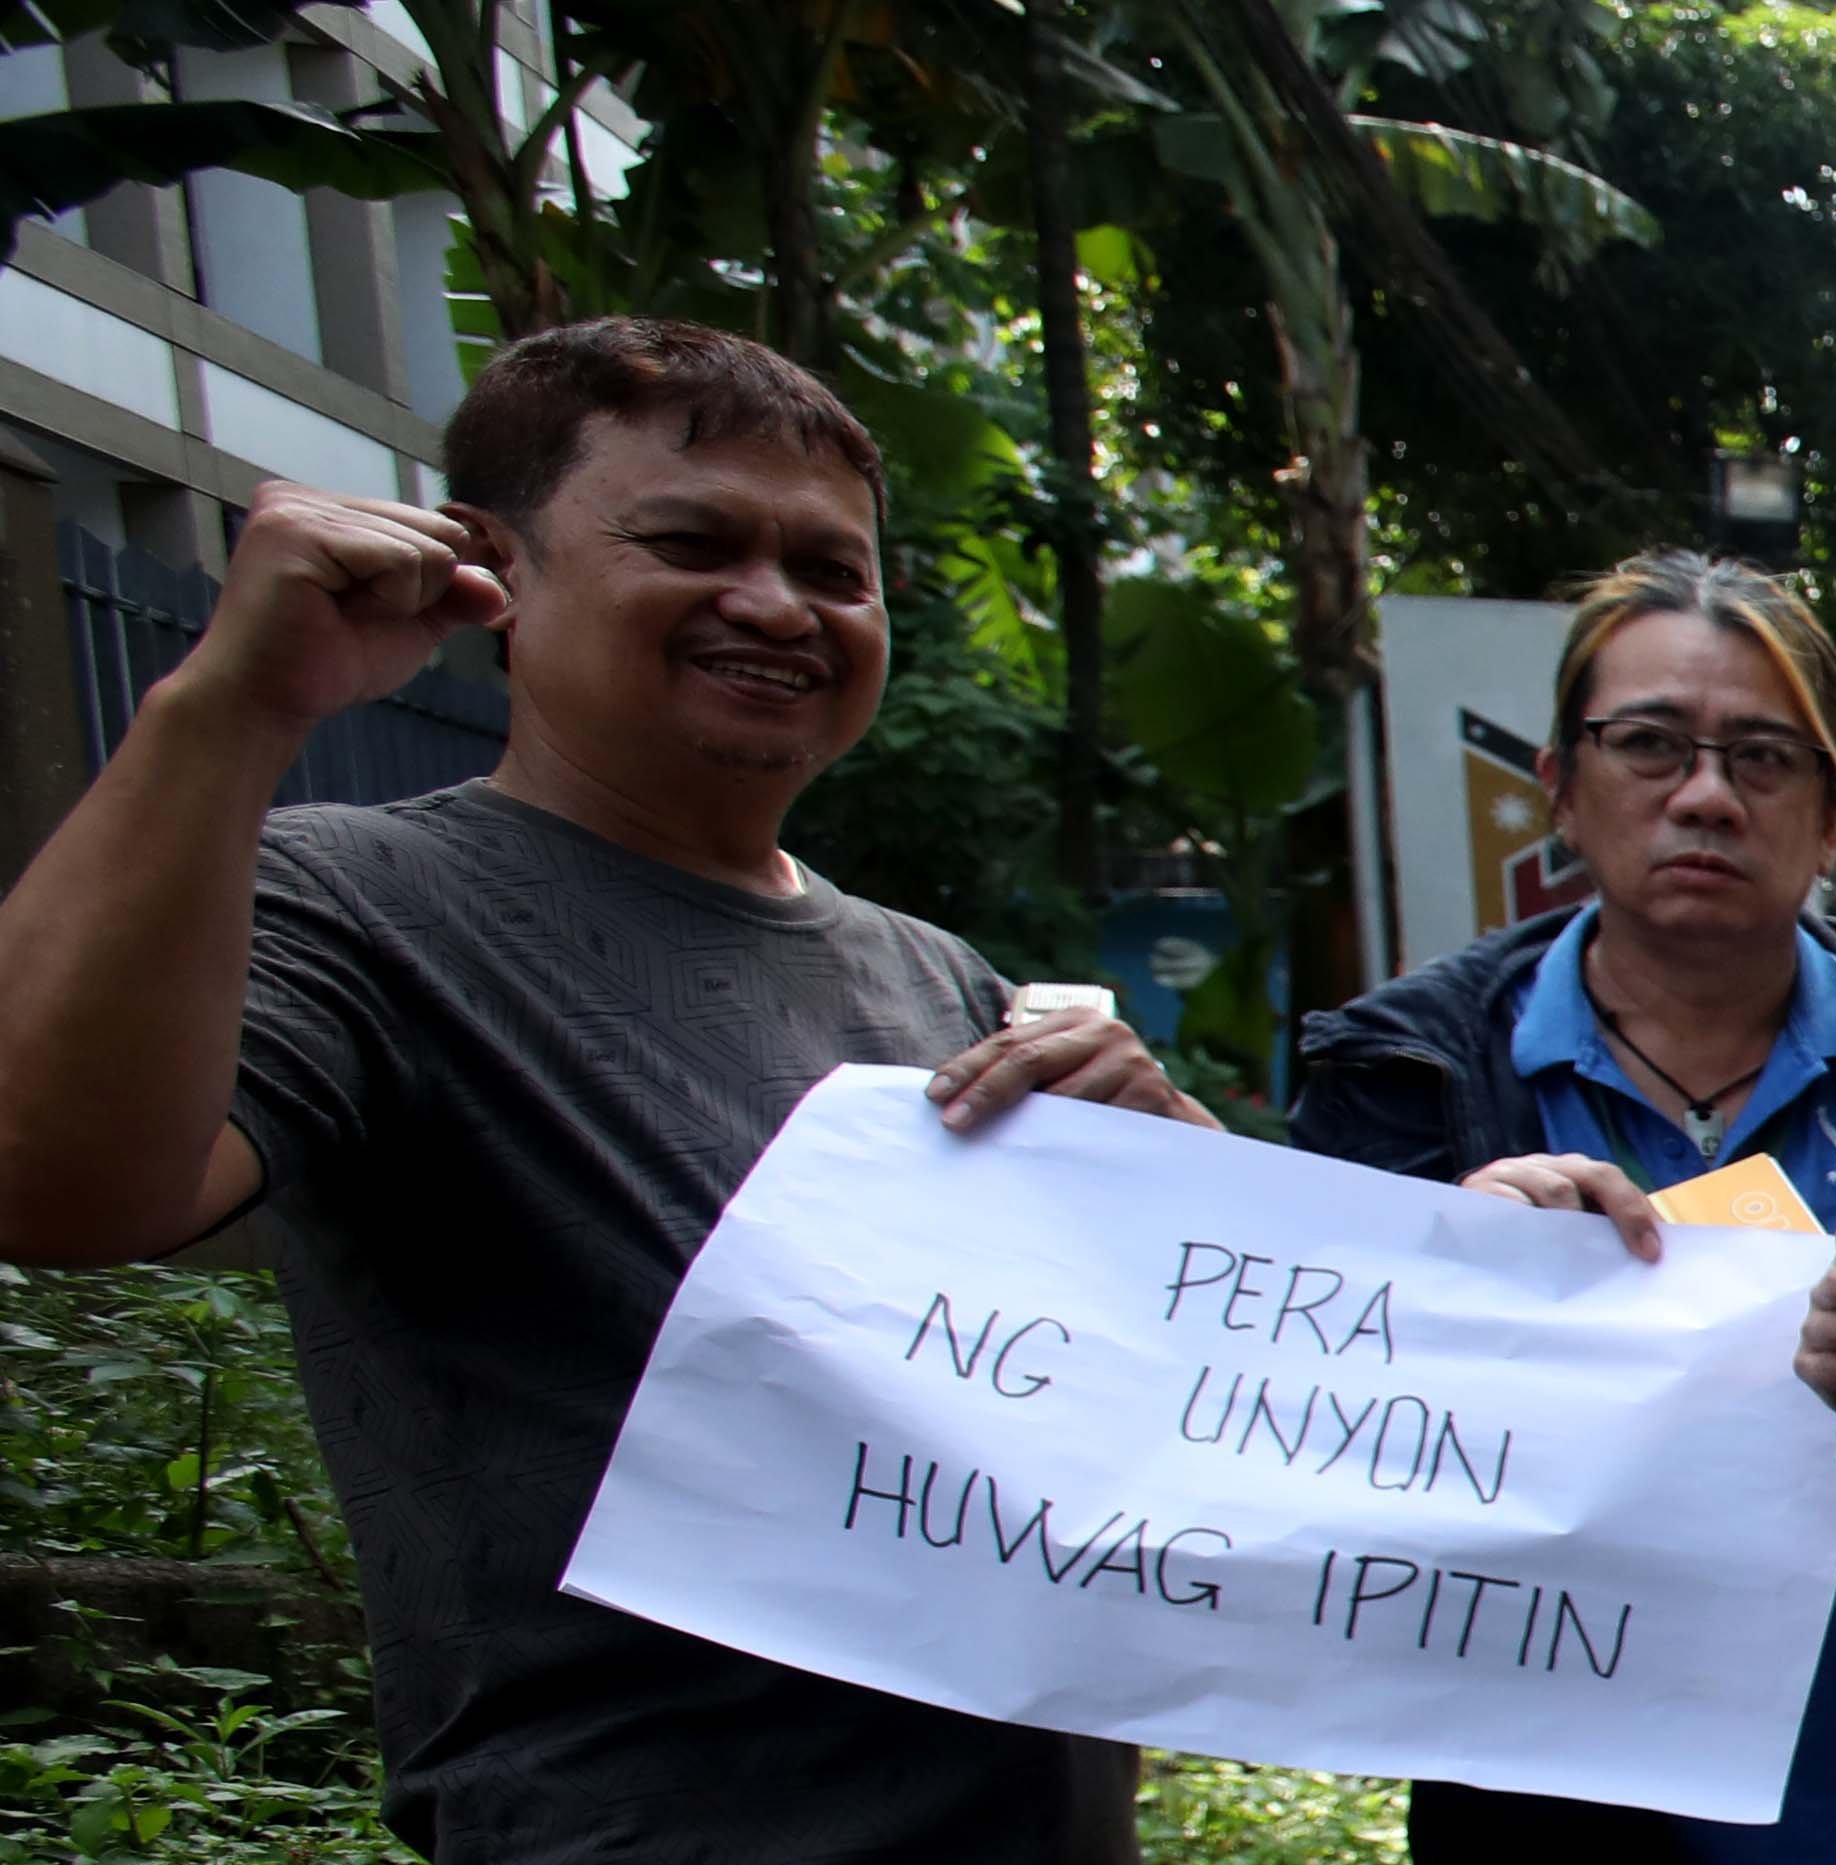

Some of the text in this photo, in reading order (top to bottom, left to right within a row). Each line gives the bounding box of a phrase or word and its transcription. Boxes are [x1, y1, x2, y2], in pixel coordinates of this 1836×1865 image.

[905, 1293, 1512, 1504] NG UNYON
[1165, 1242, 1393, 1364] PERA
[844, 1442, 1632, 1680] HUWAG IPITIN
